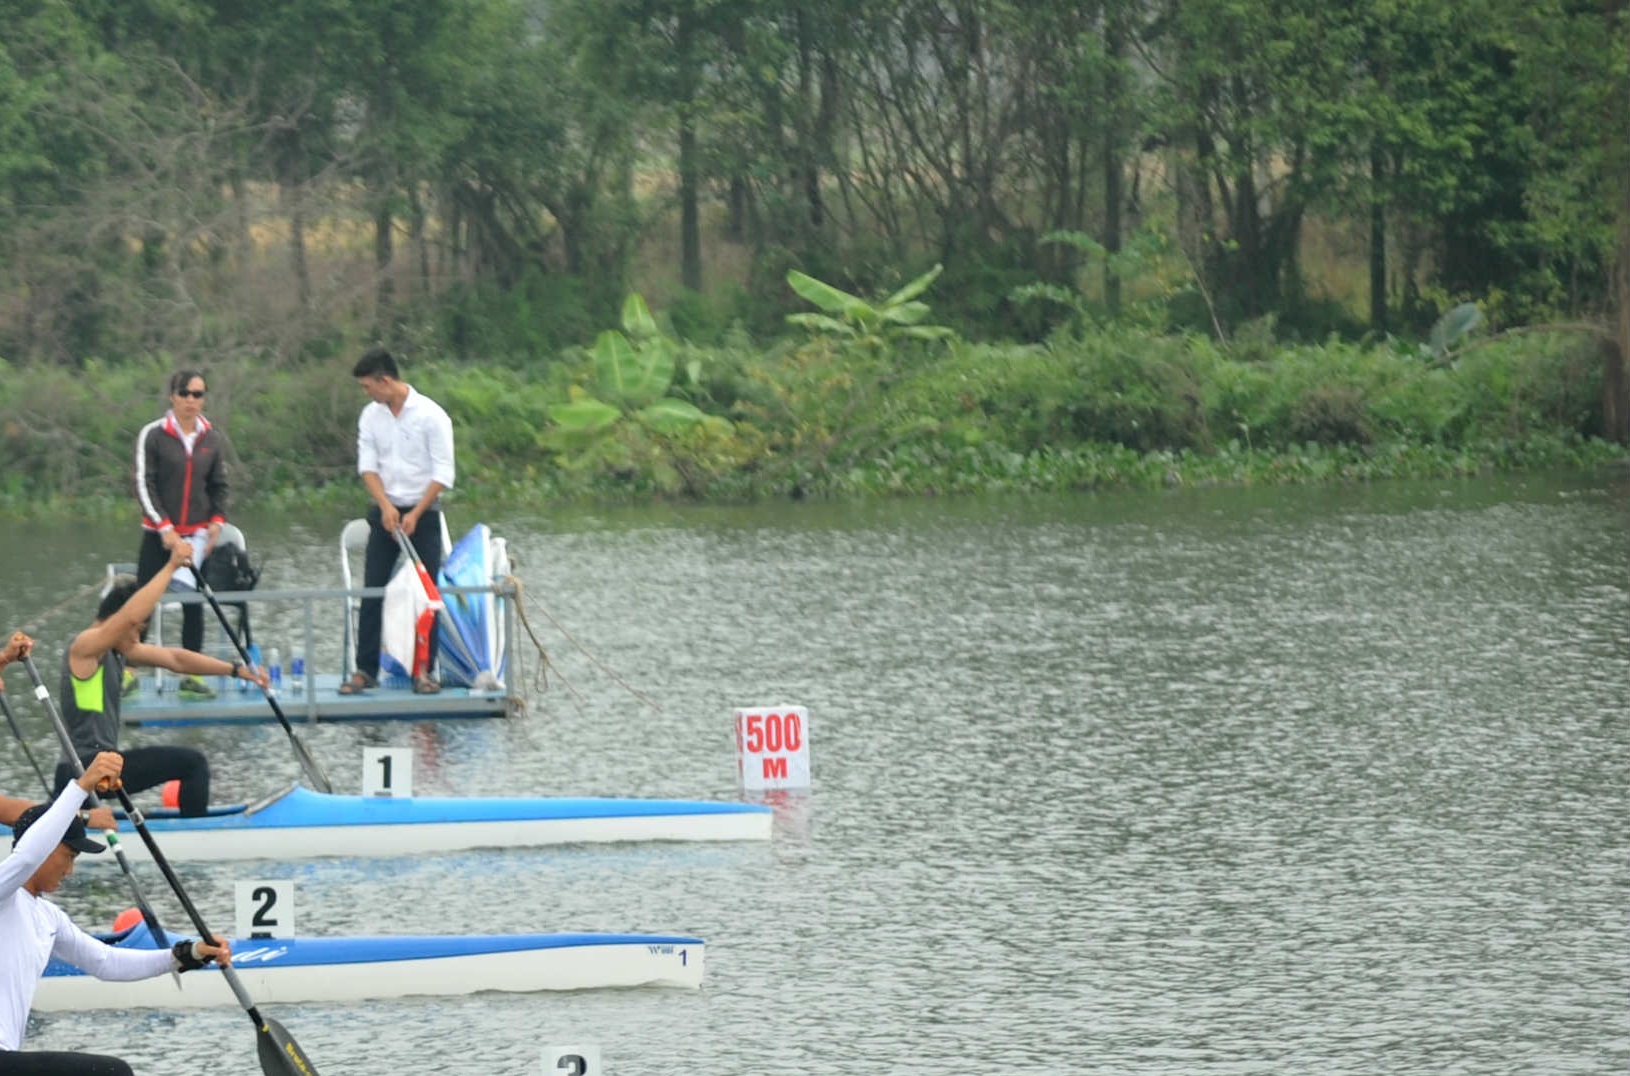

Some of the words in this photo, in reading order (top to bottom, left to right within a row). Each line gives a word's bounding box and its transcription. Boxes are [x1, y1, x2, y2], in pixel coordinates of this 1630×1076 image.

[747, 713, 801, 753] 500
[377, 755, 392, 789] 1
[763, 757, 787, 779] M
[252, 886, 278, 927] 2
[678, 949, 687, 967] 1
